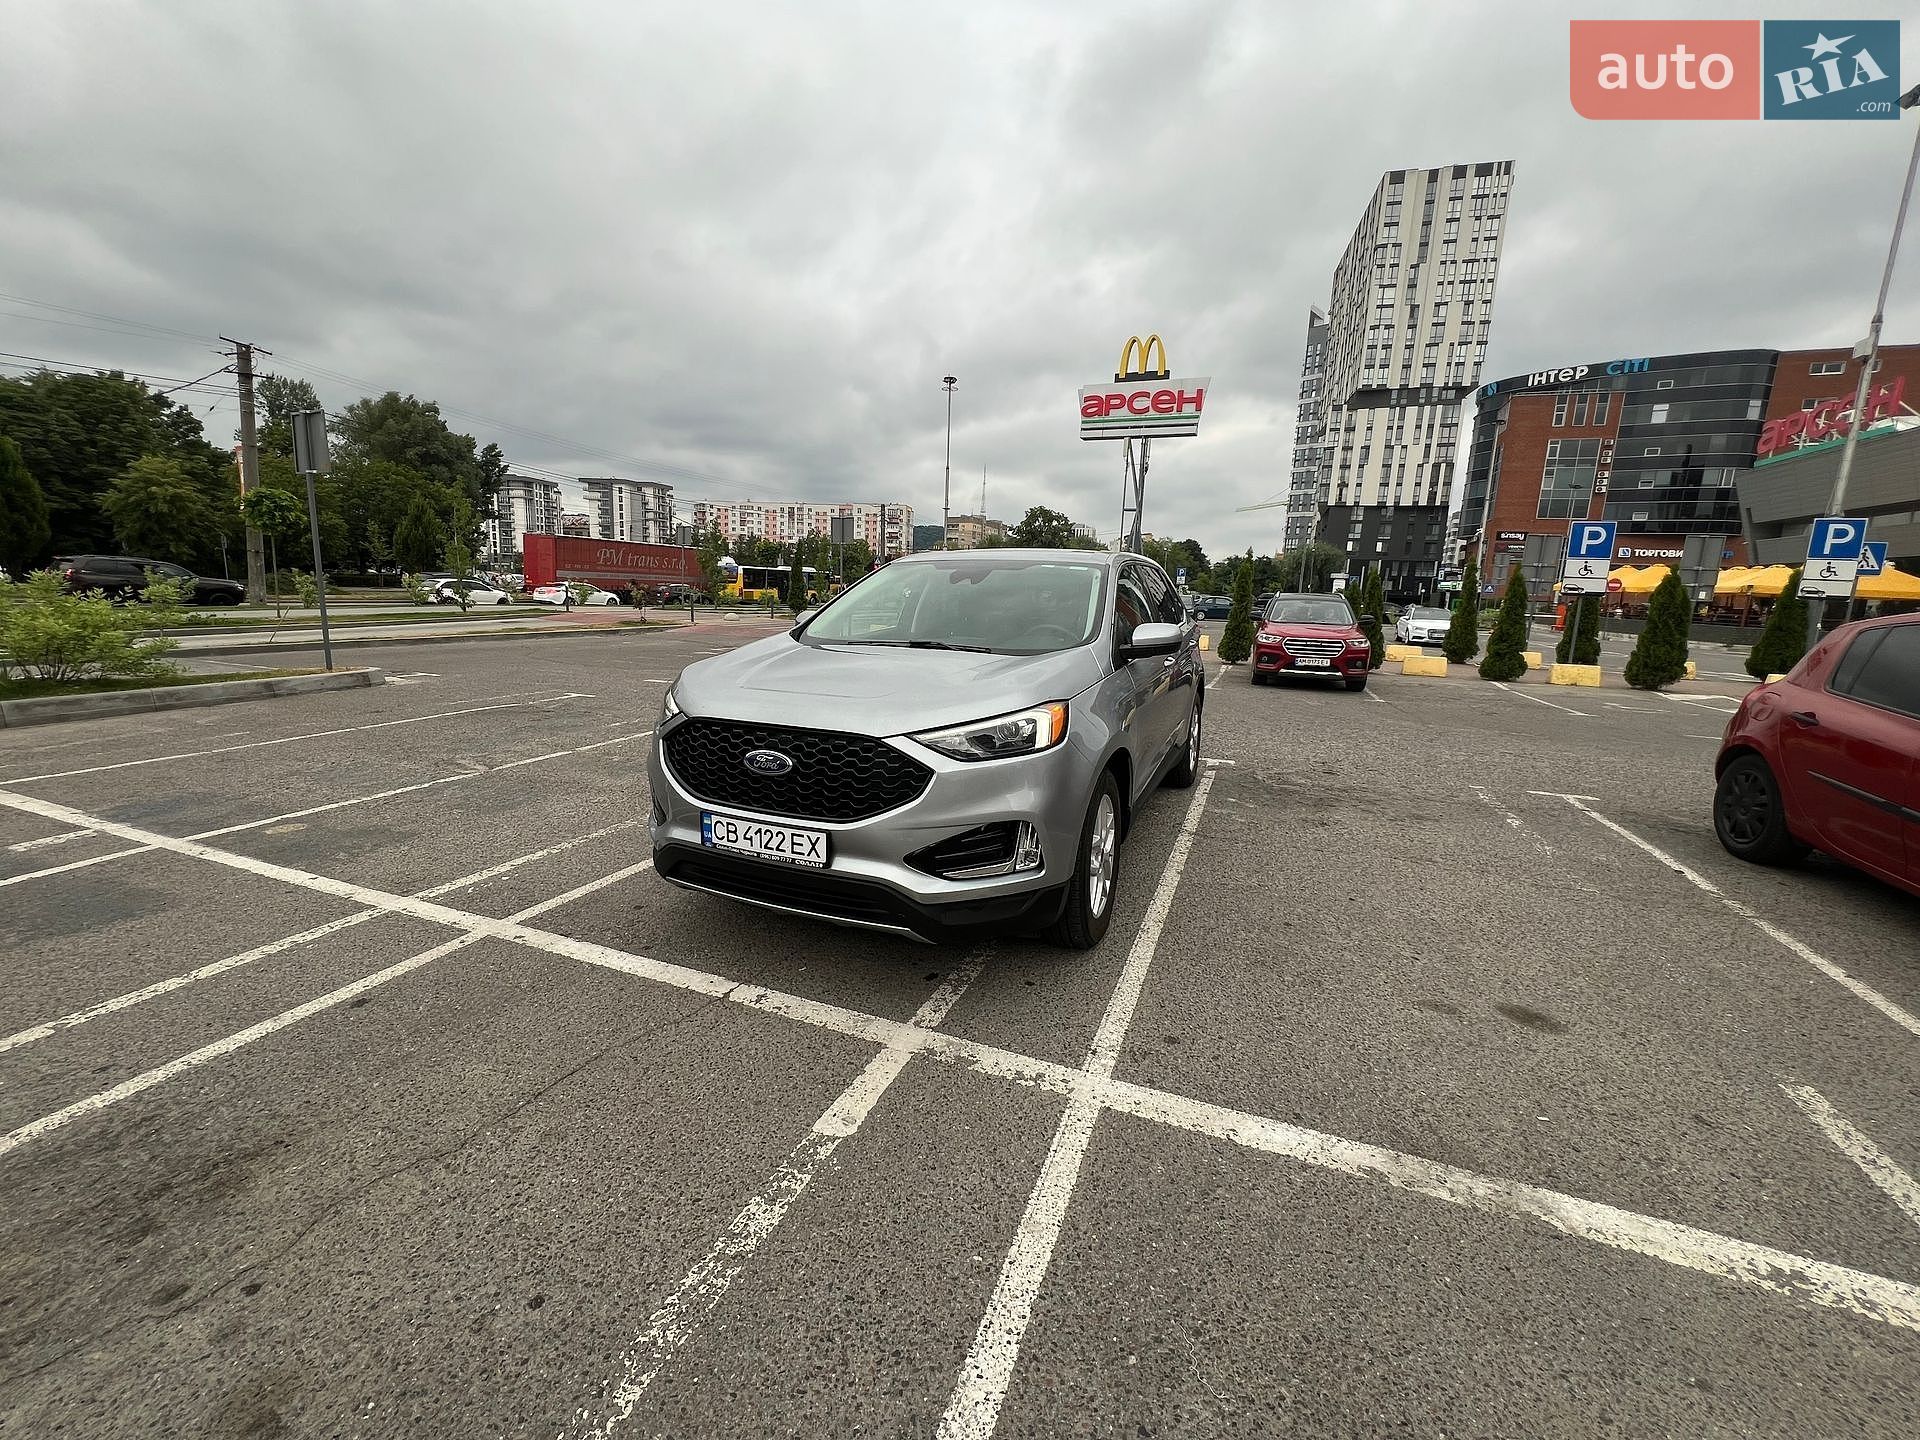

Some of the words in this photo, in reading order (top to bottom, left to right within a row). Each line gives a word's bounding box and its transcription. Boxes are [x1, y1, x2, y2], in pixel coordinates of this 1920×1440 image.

[1500, 531, 1525, 541] sinsay
[1580, 526, 1607, 555] P
[1823, 523, 1855, 555] P
[627, 552, 659, 569] trans
[1633, 549, 1684, 558] ТОРГОВИ
[752, 754, 781, 770] Ford
[713, 819, 739, 844] CB
[742, 825, 787, 854] 4122
[790, 832, 821, 859] EX
